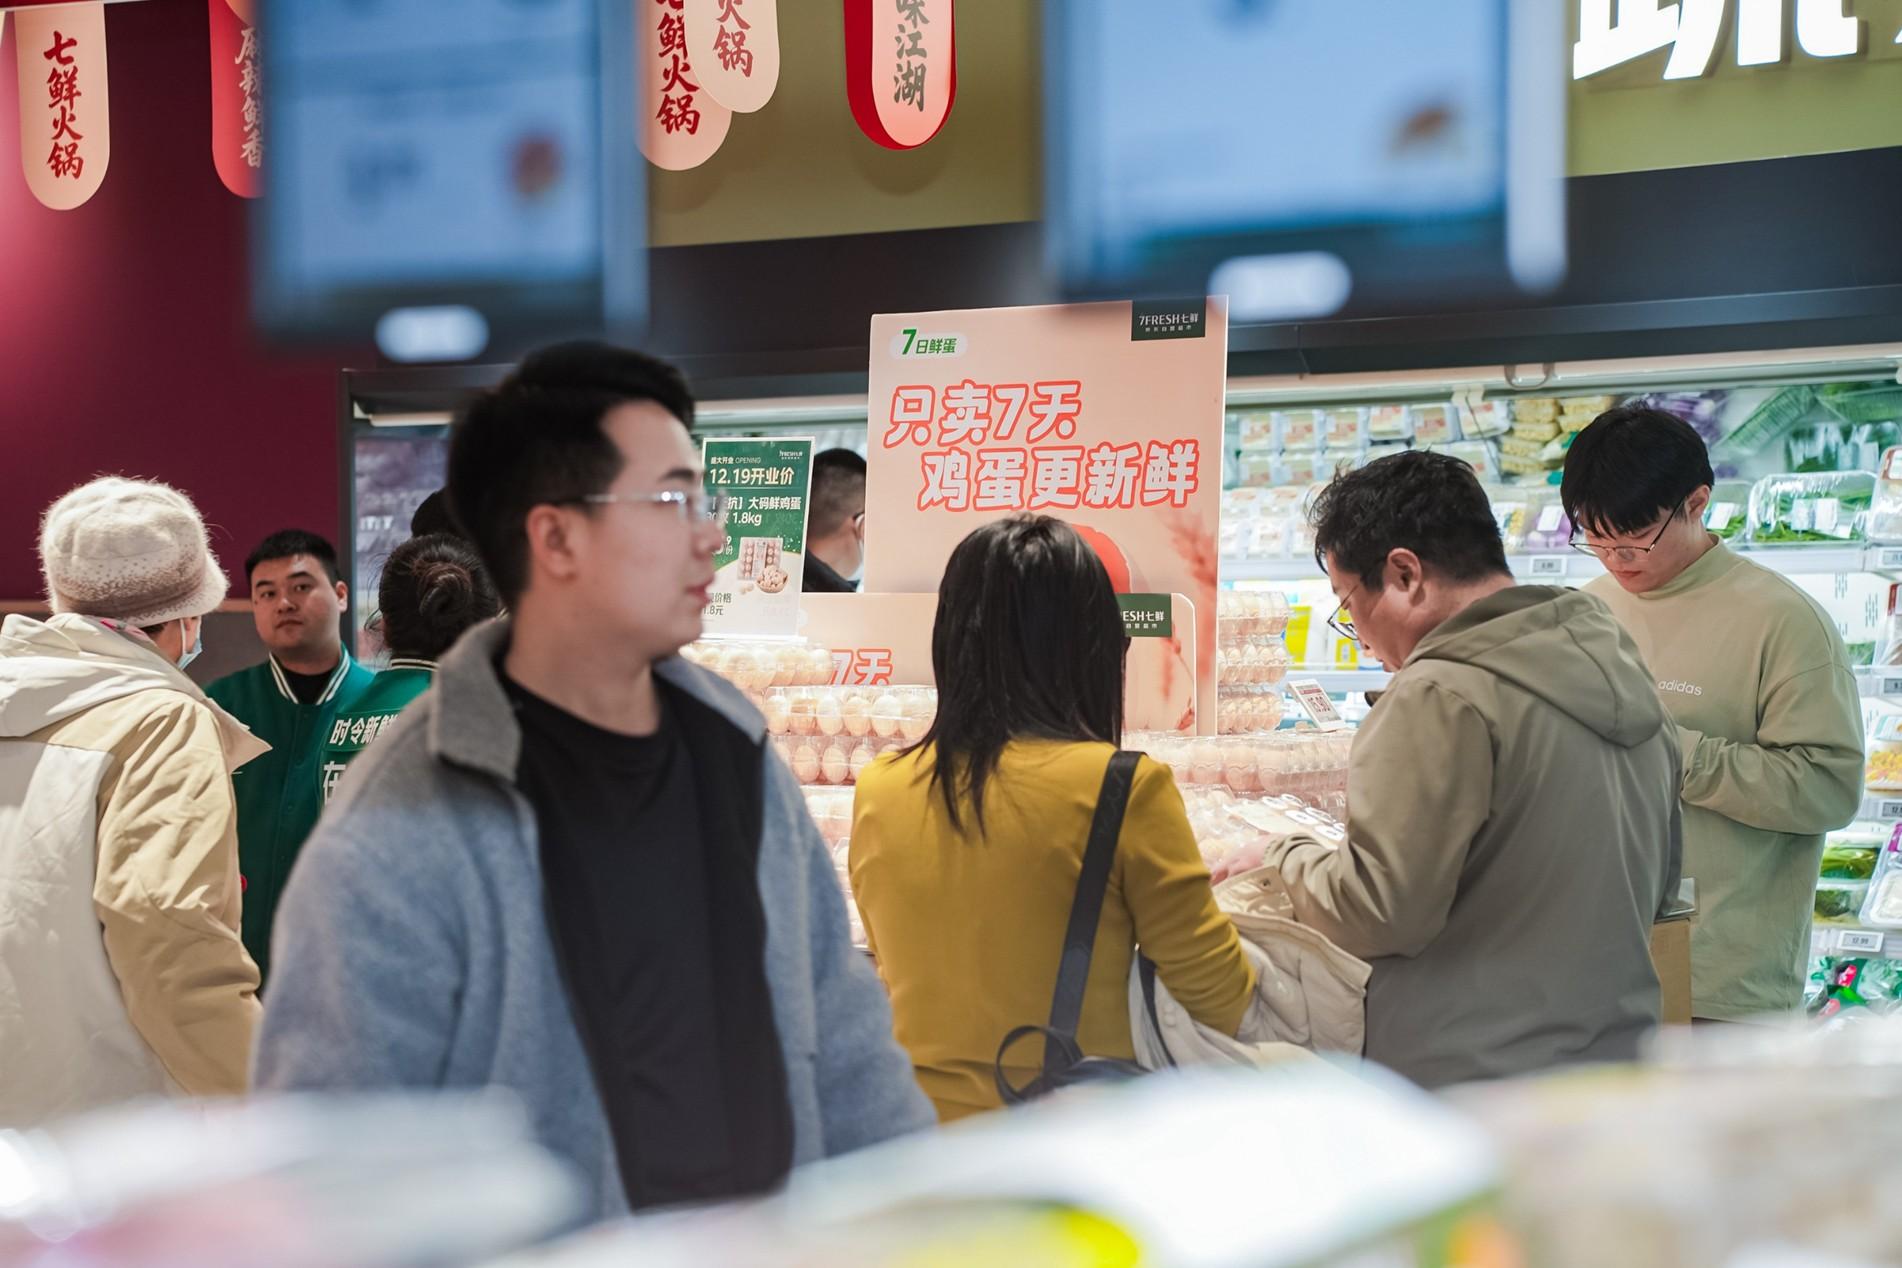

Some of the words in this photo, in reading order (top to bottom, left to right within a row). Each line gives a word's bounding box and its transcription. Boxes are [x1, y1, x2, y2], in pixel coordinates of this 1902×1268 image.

[656, 0, 700, 135] 鲜火锅
[43, 30, 83, 180] 七鲜火锅
[902, 329, 958, 355] 7日鲜蛋
[883, 379, 1082, 449] 只卖7天
[710, 467, 795, 485] 12.19开业价
[917, 439, 1199, 512] 鸡蛋更新鲜
[732, 512, 762, 526] 1.8kg
[1658, 680, 1703, 696] adidas
